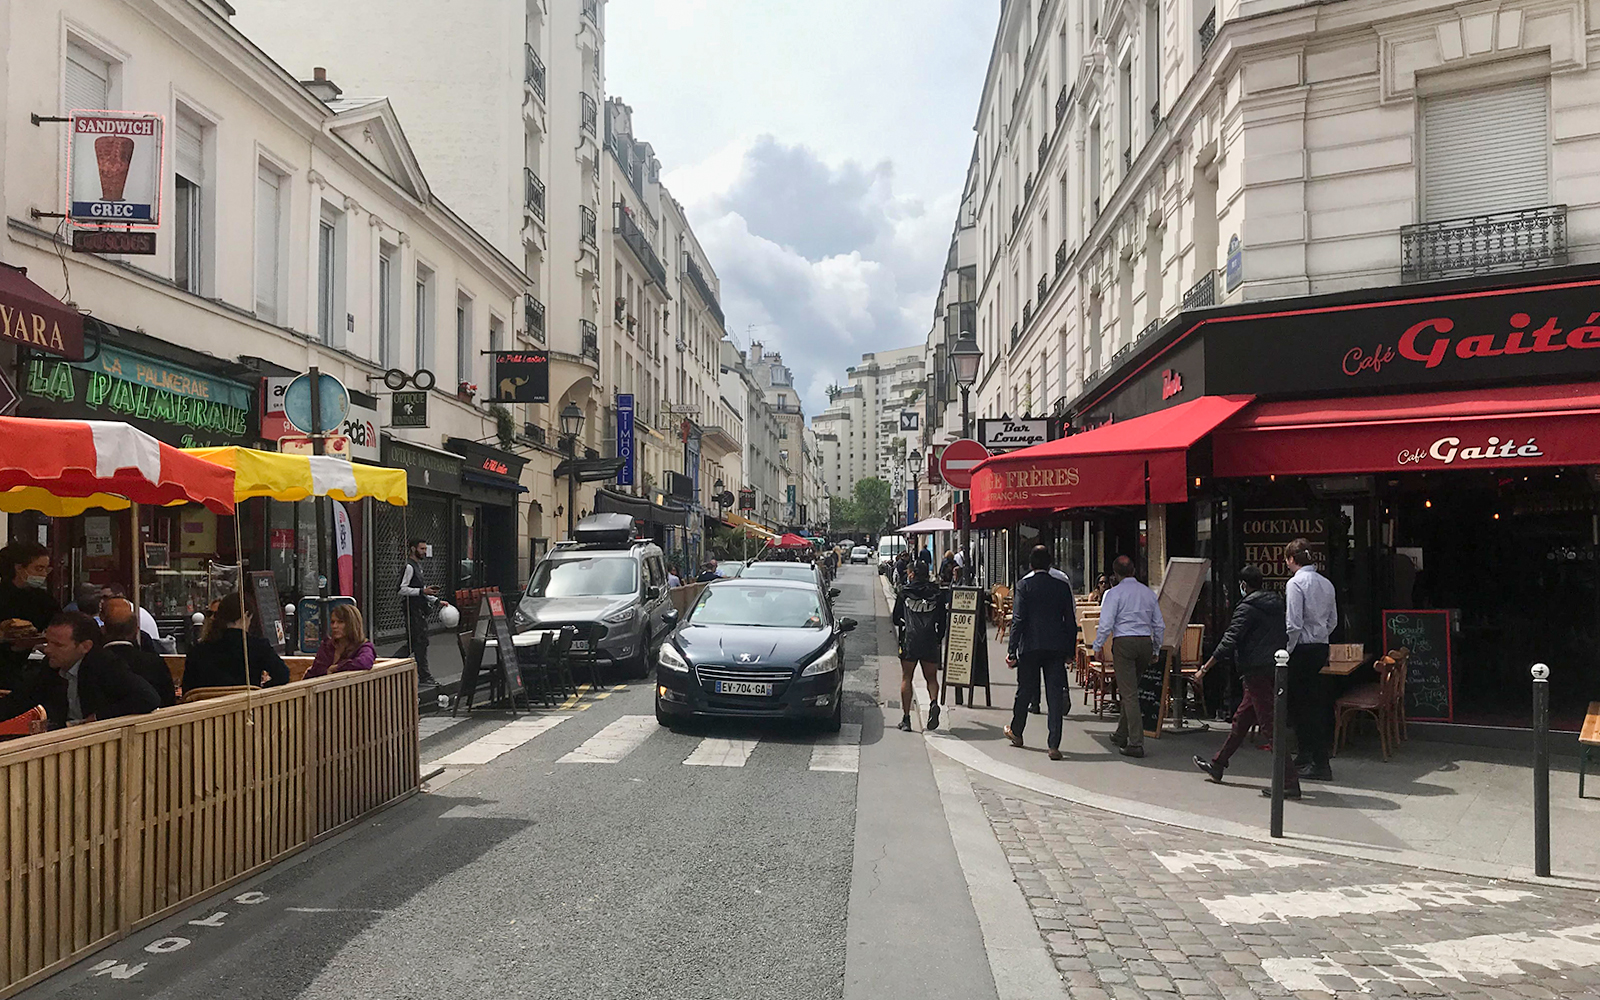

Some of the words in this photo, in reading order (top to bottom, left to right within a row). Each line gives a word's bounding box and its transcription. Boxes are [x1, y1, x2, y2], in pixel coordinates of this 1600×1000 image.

[78, 119, 152, 134] SANDWICH
[90, 203, 134, 217] GREC
[0, 304, 65, 351] YARA
[1342, 345, 1395, 377] Café
[103, 358, 122, 375] LA
[136, 363, 210, 397] PALMERAIE
[394, 393, 426, 407] OPTIQUE
[343, 419, 366, 446] ada
[1003, 422, 1029, 433] Bar
[989, 433, 1043, 446] Lounge
[1398, 450, 1427, 465] Café
[1429, 436, 1543, 464] Gaité
[1006, 465, 1080, 488] FRÈRES
[1243, 519, 1324, 534] COCKTAILS
[1245, 546, 1287, 562] HAP
[953, 614, 966, 624] 5,00
[967, 616, 972, 625] €
[951, 652, 963, 662] 7,00
[964, 653, 969, 662] €
[722, 682, 768, 695] EV-704-GA
